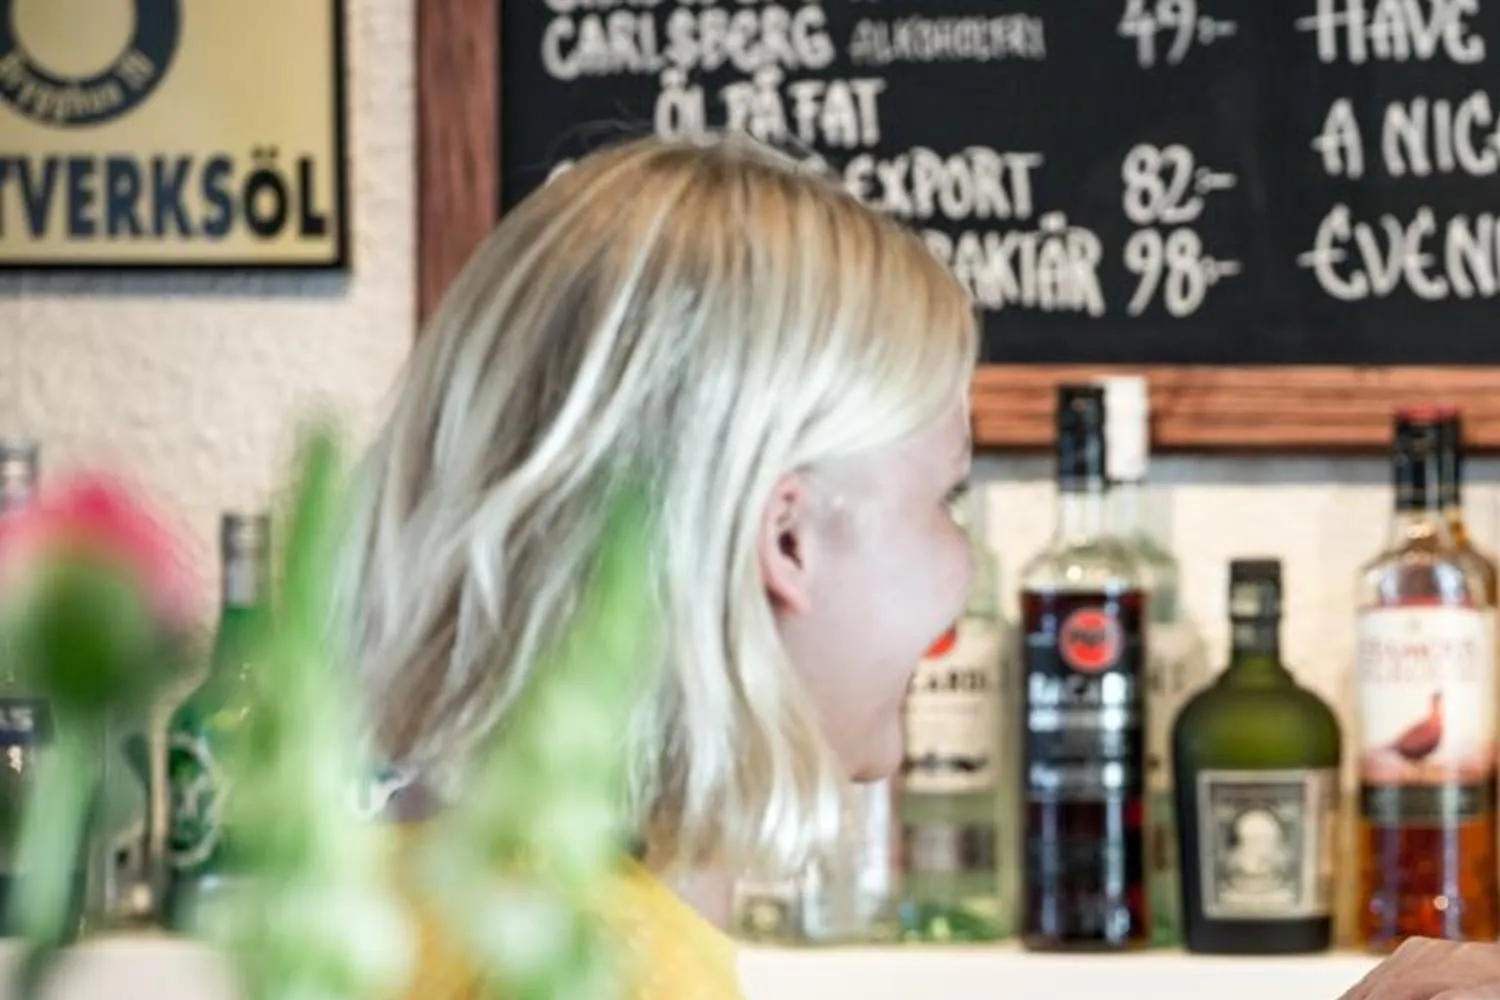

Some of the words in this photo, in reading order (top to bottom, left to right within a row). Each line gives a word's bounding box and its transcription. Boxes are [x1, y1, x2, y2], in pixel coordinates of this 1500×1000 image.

[543, 5, 836, 81] CARLSBERG
[1296, 0, 1485, 64] HAVE
[653, 64, 722, 147] ÖL
[787, 77, 888, 148] FAT
[1310, 97, 1364, 180] A
[843, 145, 1045, 219] EXPORT
